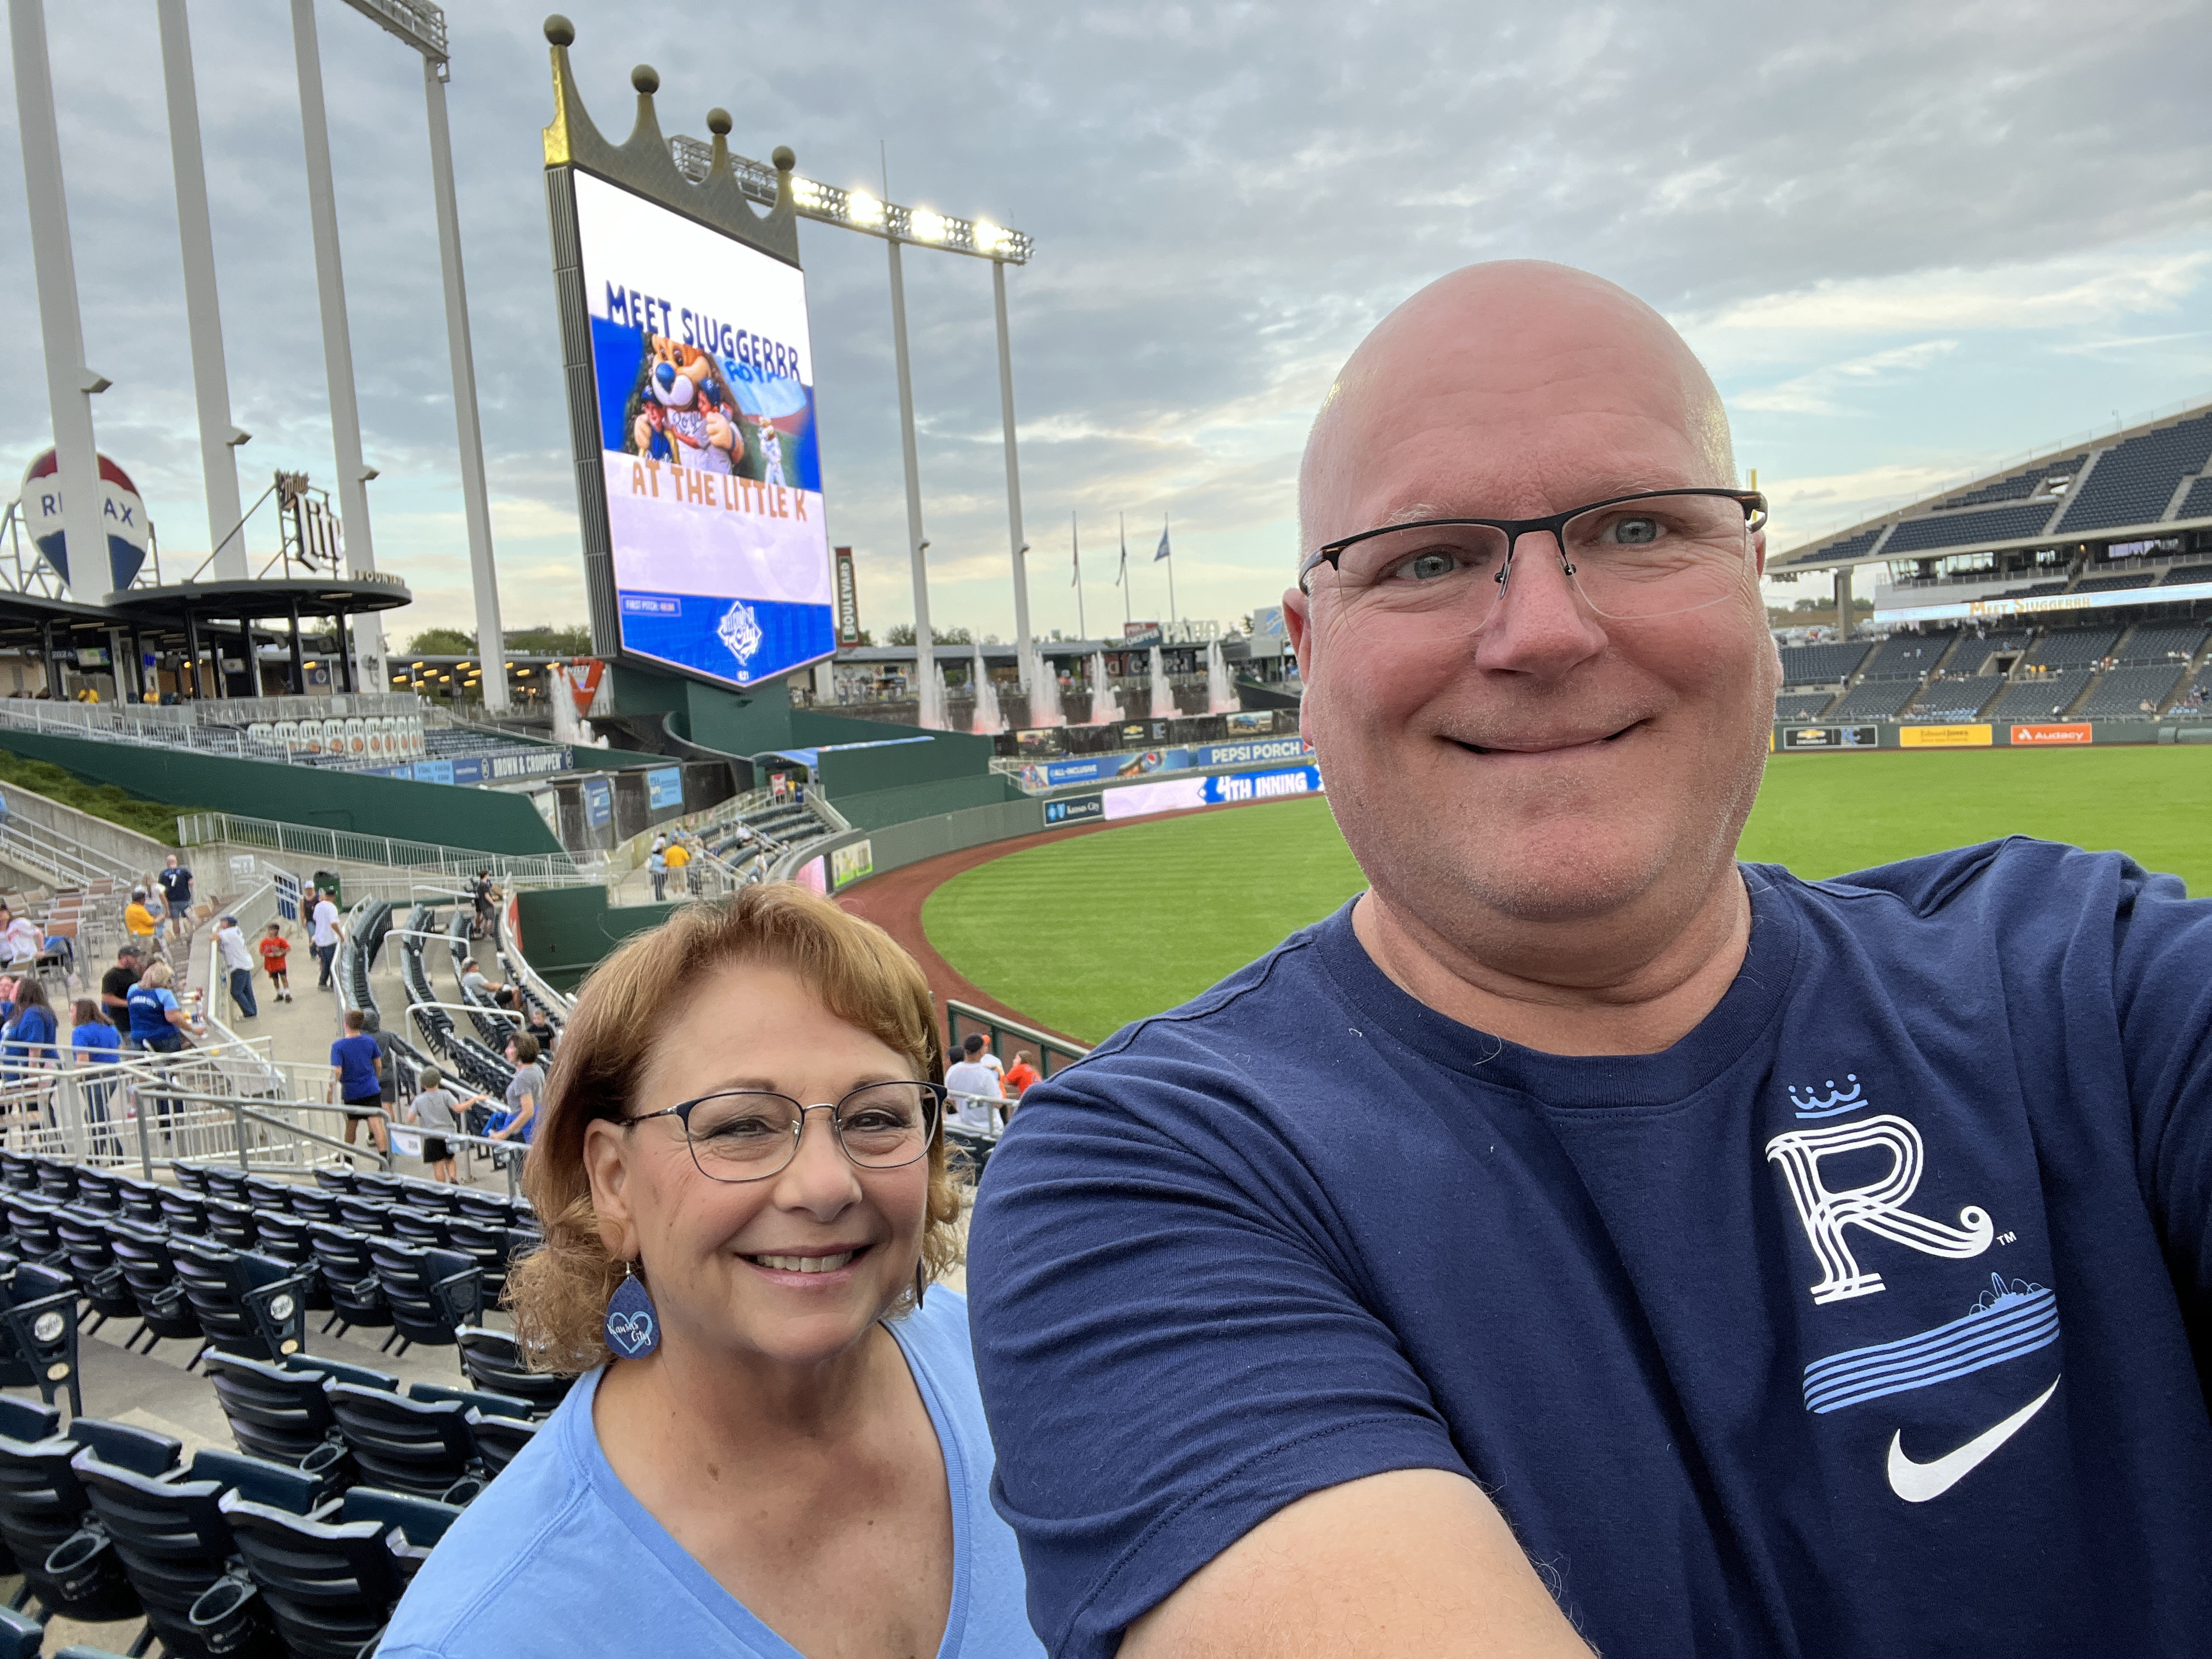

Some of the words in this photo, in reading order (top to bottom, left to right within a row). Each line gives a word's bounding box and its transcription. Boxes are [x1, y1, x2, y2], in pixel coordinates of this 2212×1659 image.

[606, 280, 671, 338] MEET
[681, 307, 800, 385] SLUGGERRR
[633, 459, 660, 497] AT
[671, 467, 717, 506] THE
[724, 475, 788, 518] LITTLE
[795, 488, 808, 522] K
[840, 562, 855, 635] BOULEVARD
[2034, 731, 2084, 741] Audacy
[1211, 746, 1251, 763] PEPSI
[1252, 741, 1301, 759] PORCH
[493, 757, 519, 777] BROWN
[520, 755, 526, 774] &
[526, 752, 562, 774] CROUPPEN
[1054, 764, 1097, 776] ALL-INCLUSIVE
[1216, 775, 1252, 801] 4TH
[1255, 772, 1307, 798] INNING
[1066, 805, 1087, 815] Kansas
[1087, 802, 1100, 812] City
[169, 873, 176, 887] 7
[1765, 1114, 1995, 1306] R
[1996, 1231, 2017, 1246] TM
[606, 1321, 639, 1335] Kansas
[631, 1330, 652, 1346] City
